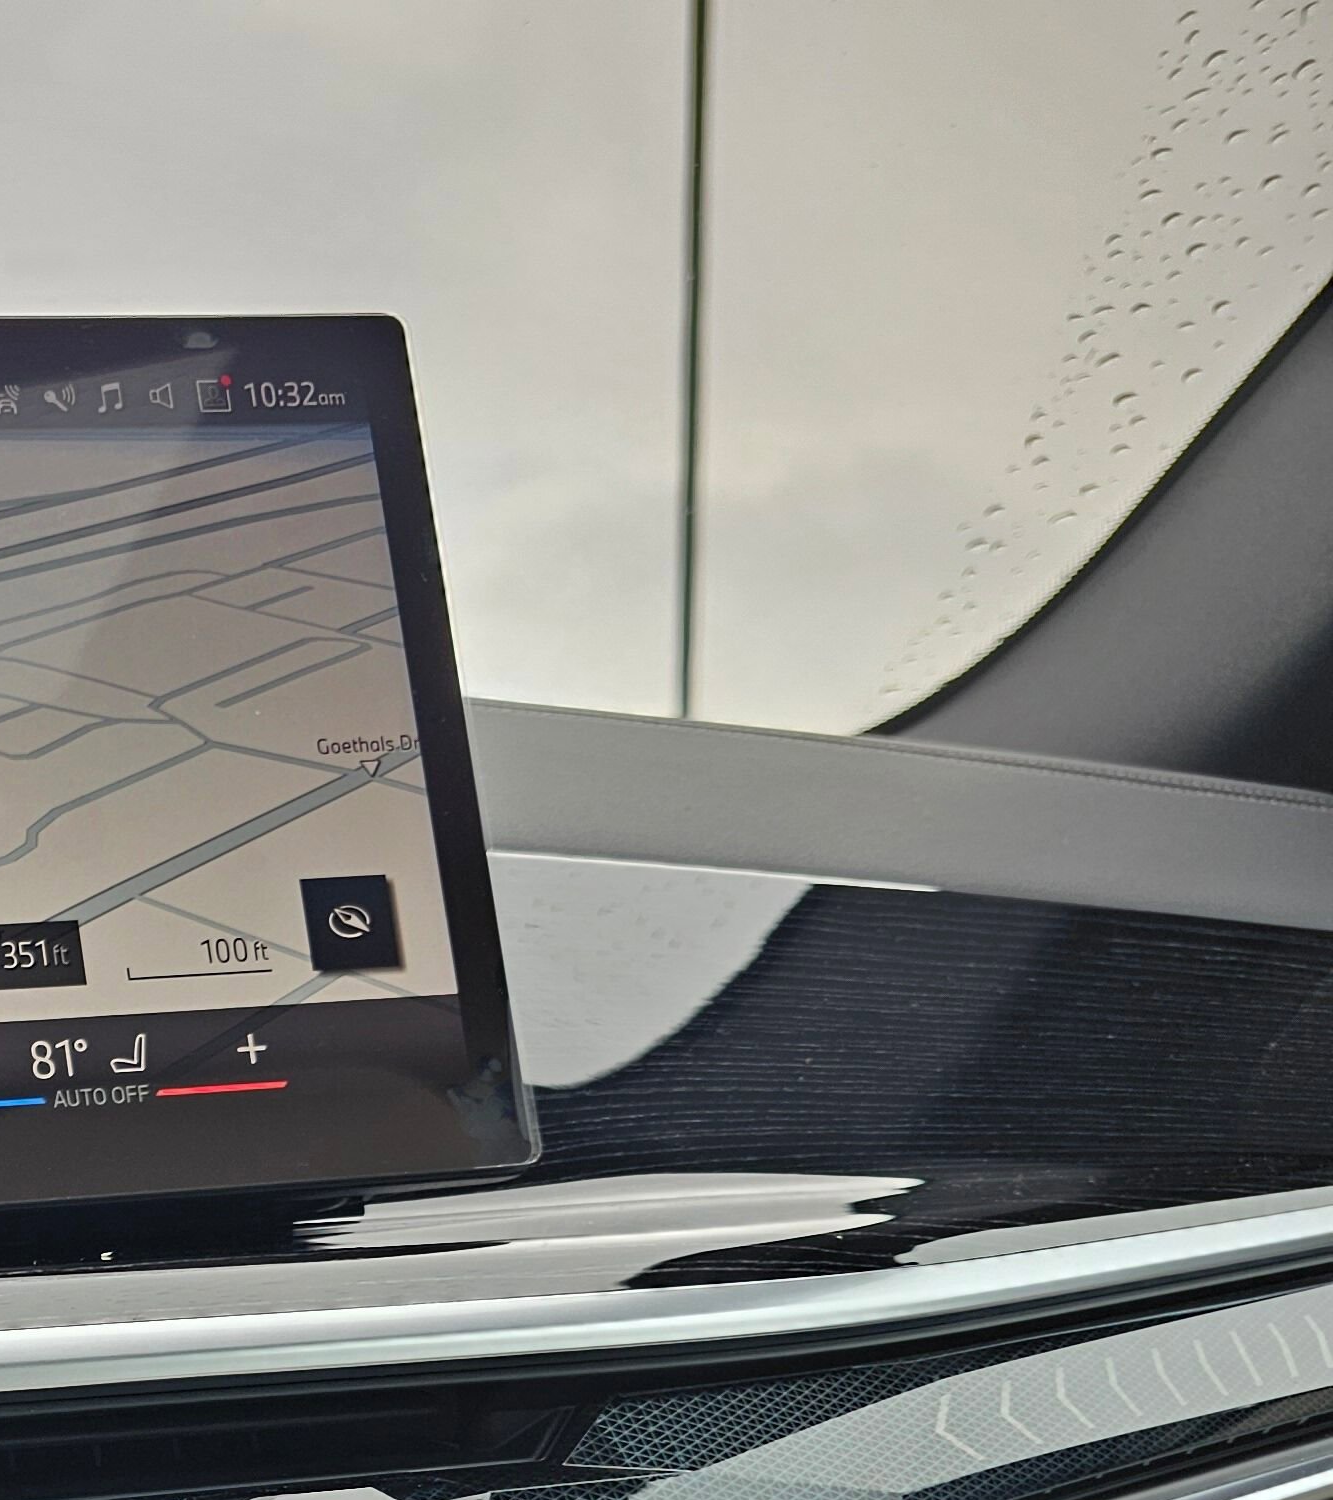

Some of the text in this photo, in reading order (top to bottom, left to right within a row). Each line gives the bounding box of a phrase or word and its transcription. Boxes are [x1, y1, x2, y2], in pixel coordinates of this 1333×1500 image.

[317, 734, 420, 755] Goethals Dr
[53, 1085, 149, 1108] AUTO OFF
